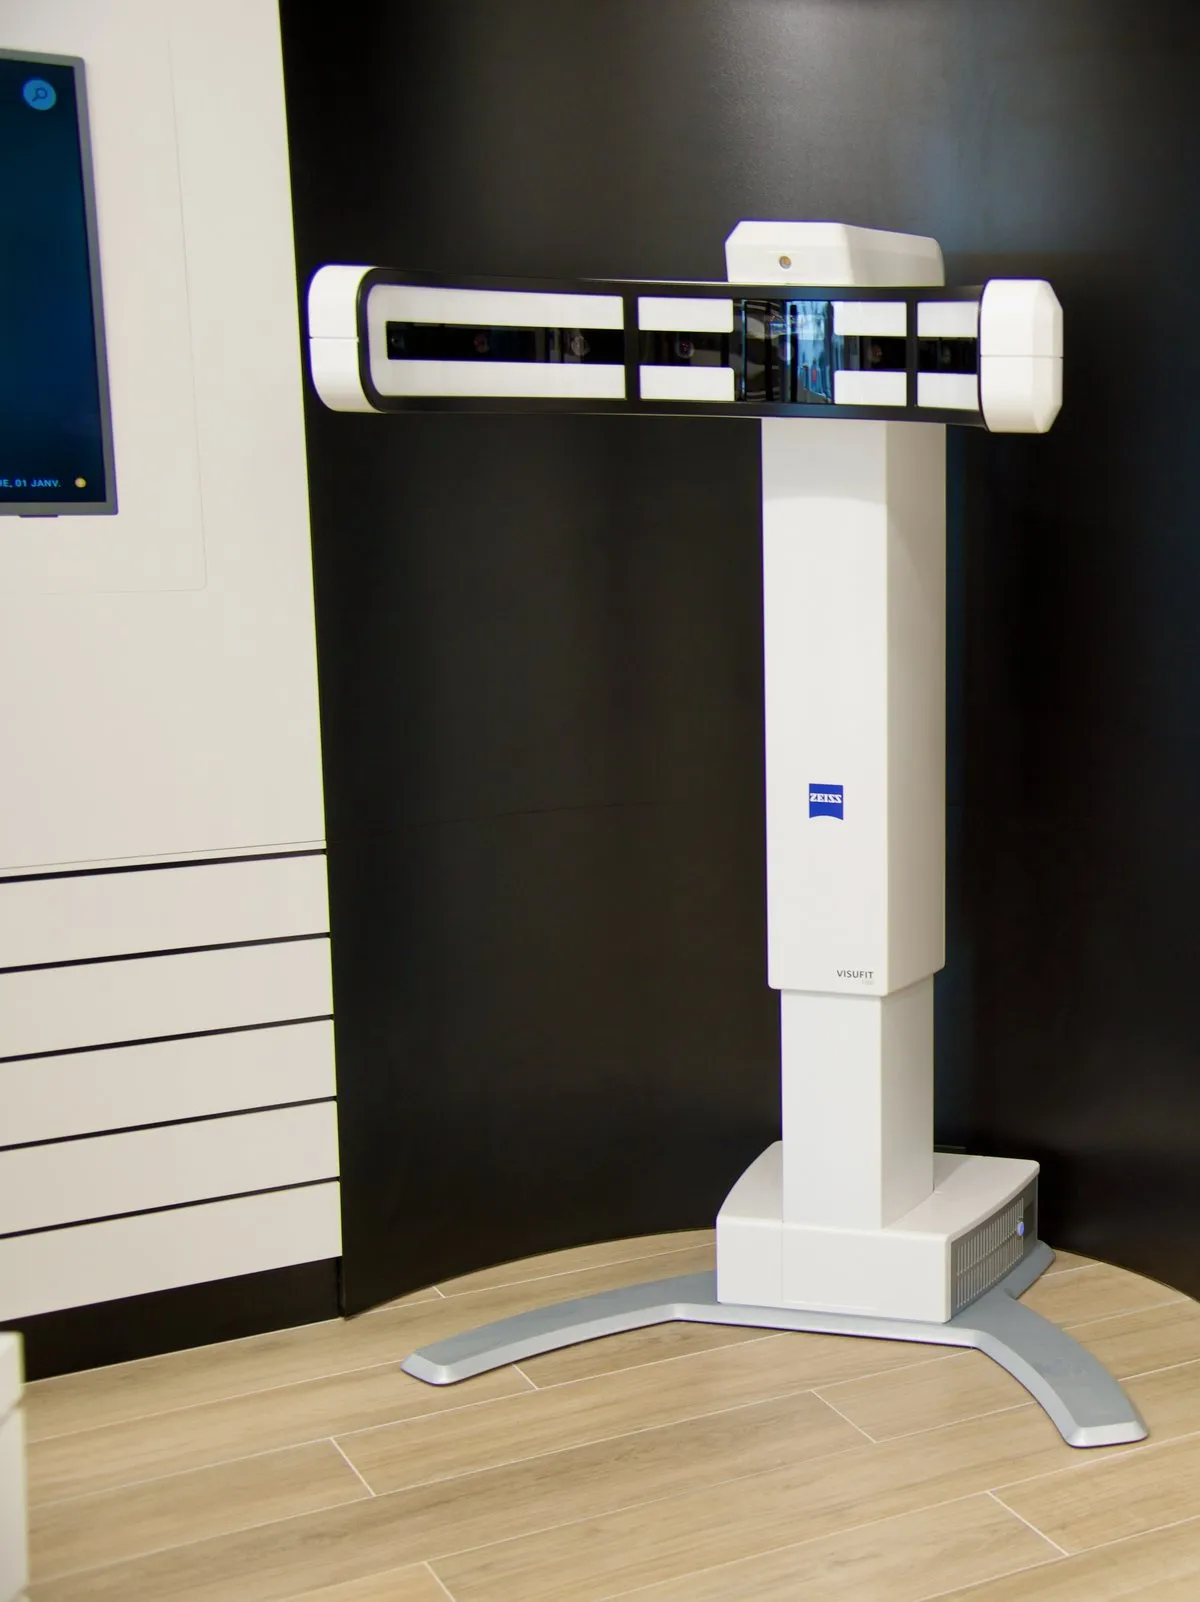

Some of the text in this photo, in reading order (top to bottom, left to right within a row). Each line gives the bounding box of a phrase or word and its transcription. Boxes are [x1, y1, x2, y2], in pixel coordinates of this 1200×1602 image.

[15, 479, 27, 487] 01
[31, 479, 61, 487] JANV.
[809, 793, 842, 803] ZEISS
[836, 969, 874, 979] VISUFIT
